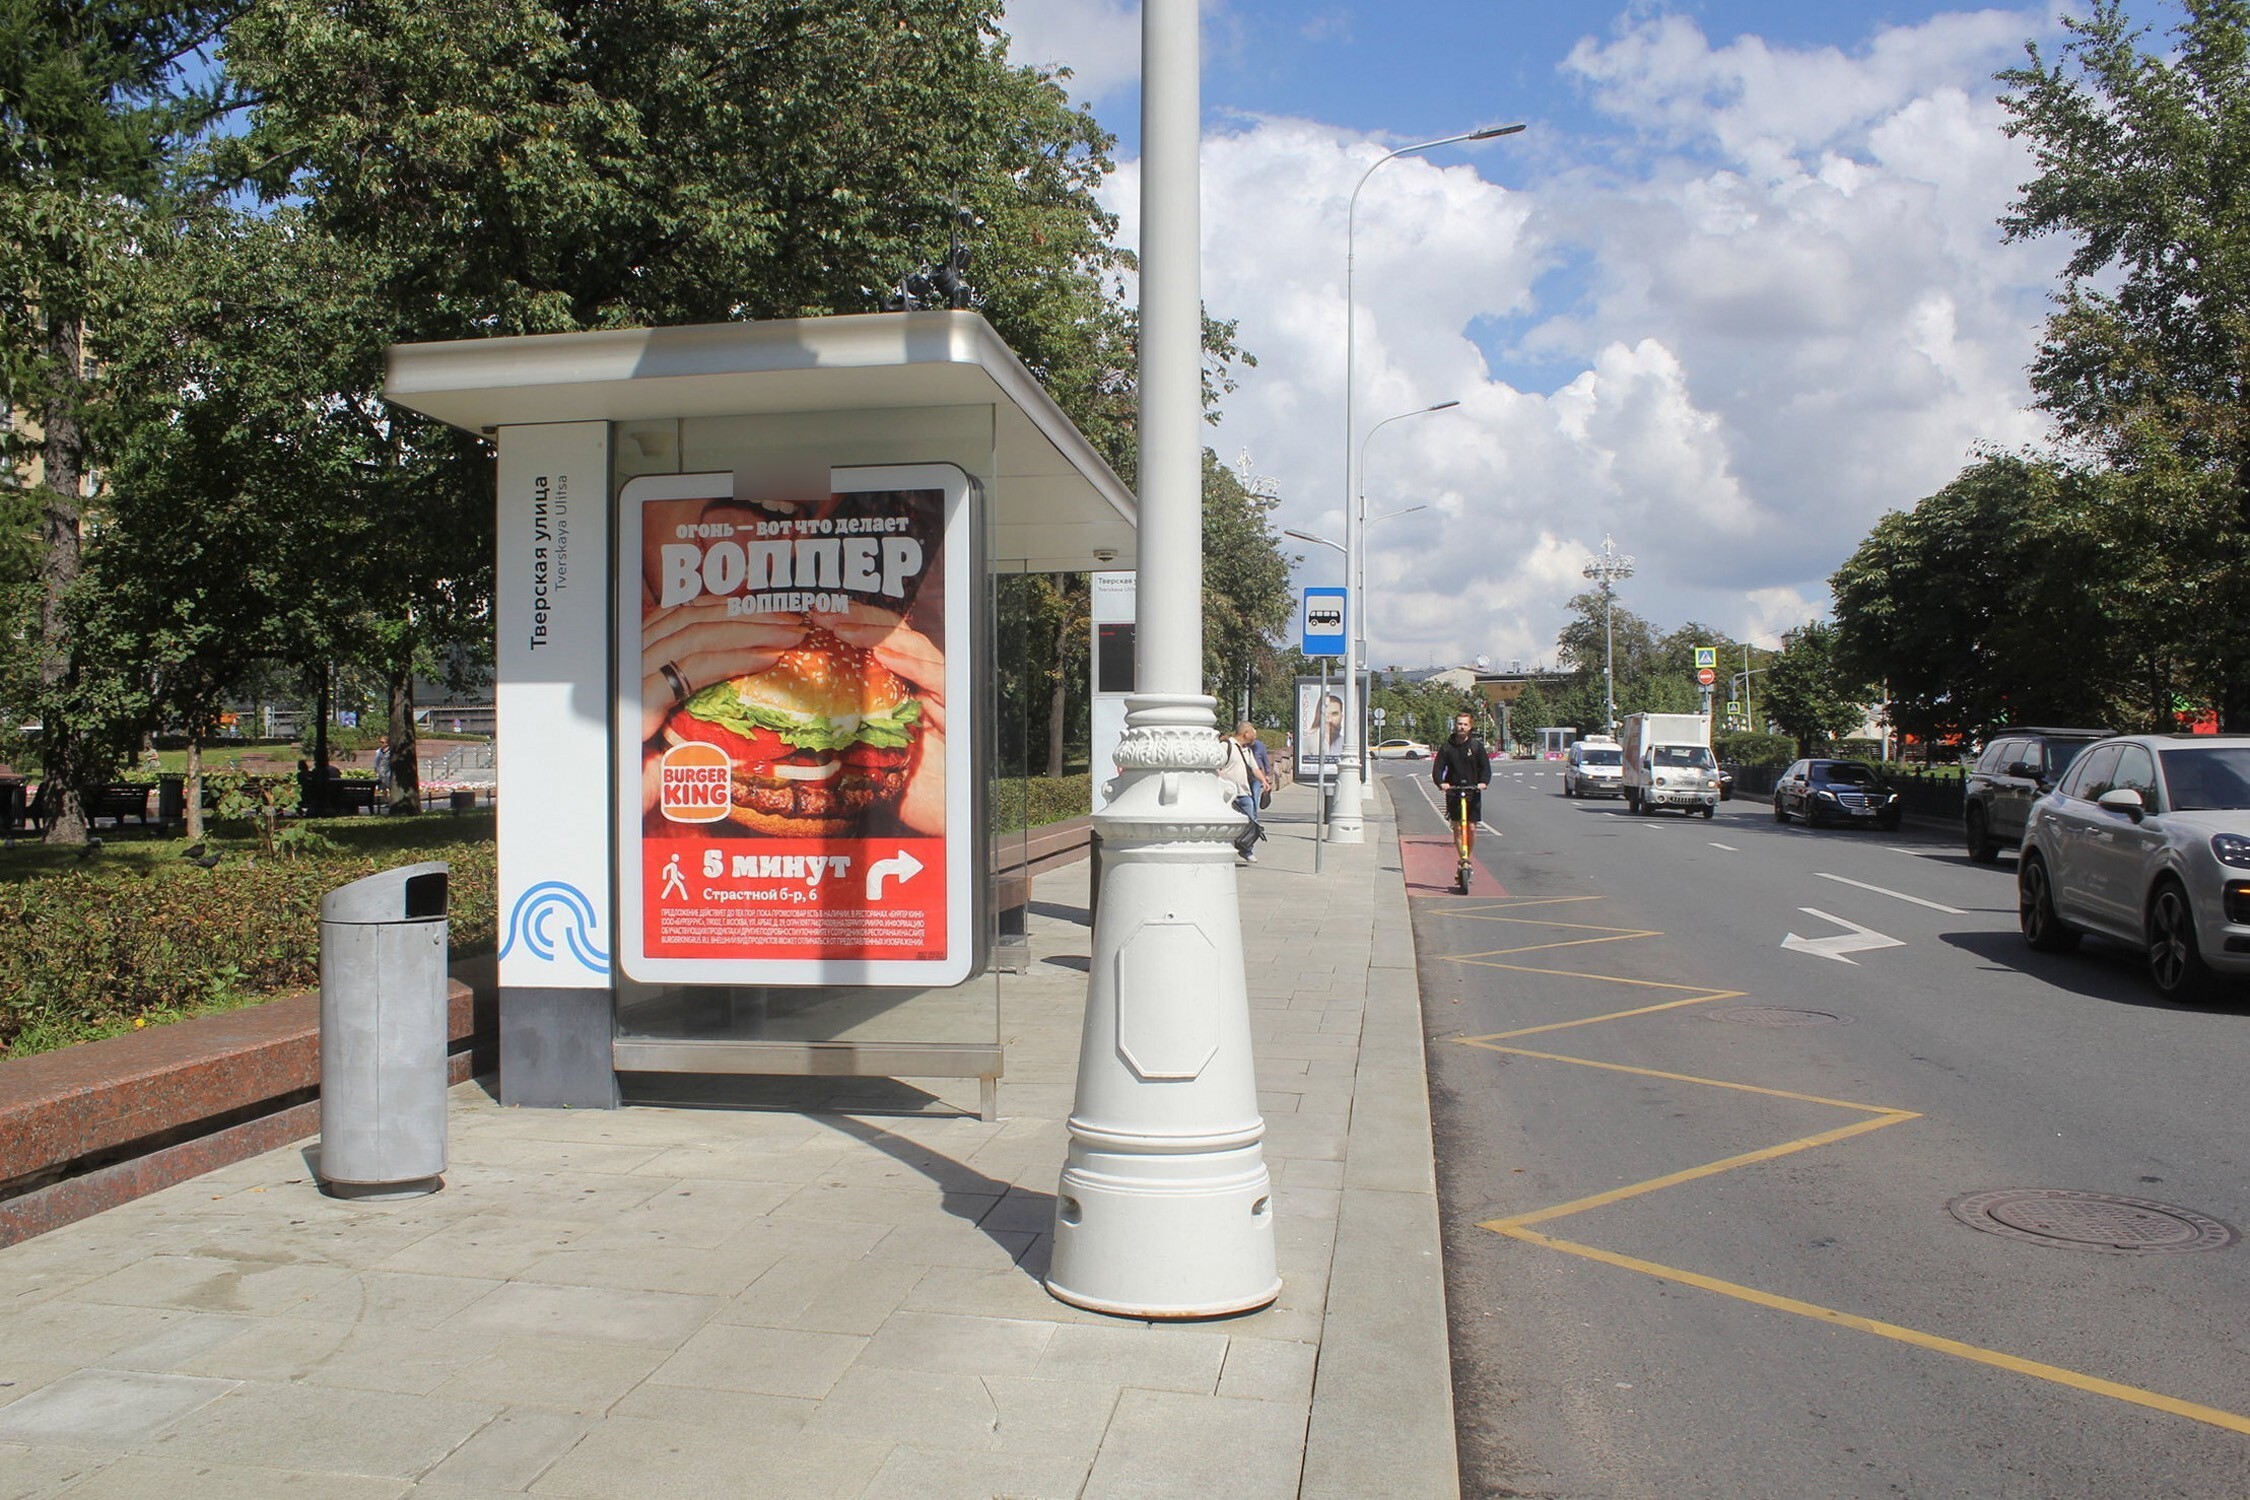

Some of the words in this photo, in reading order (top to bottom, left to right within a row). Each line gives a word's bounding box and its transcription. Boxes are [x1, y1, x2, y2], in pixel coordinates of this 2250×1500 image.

[534, 476, 551, 541] улица
[555, 475, 567, 514] Ulitsa
[835, 517, 909, 534] делает
[555, 520, 569, 591] Tverskaya
[531, 547, 551, 650] Тверская
[727, 592, 850, 617] ВОППЕРОМ
[664, 768, 727, 783] BURGER
[664, 784, 727, 805] KING
[702, 849, 724, 878] 5
[732, 855, 851, 886] минут
[703, 888, 777, 902] Страстной
[779, 887, 806, 903] б-р,
[808, 889, 818, 900] 6
